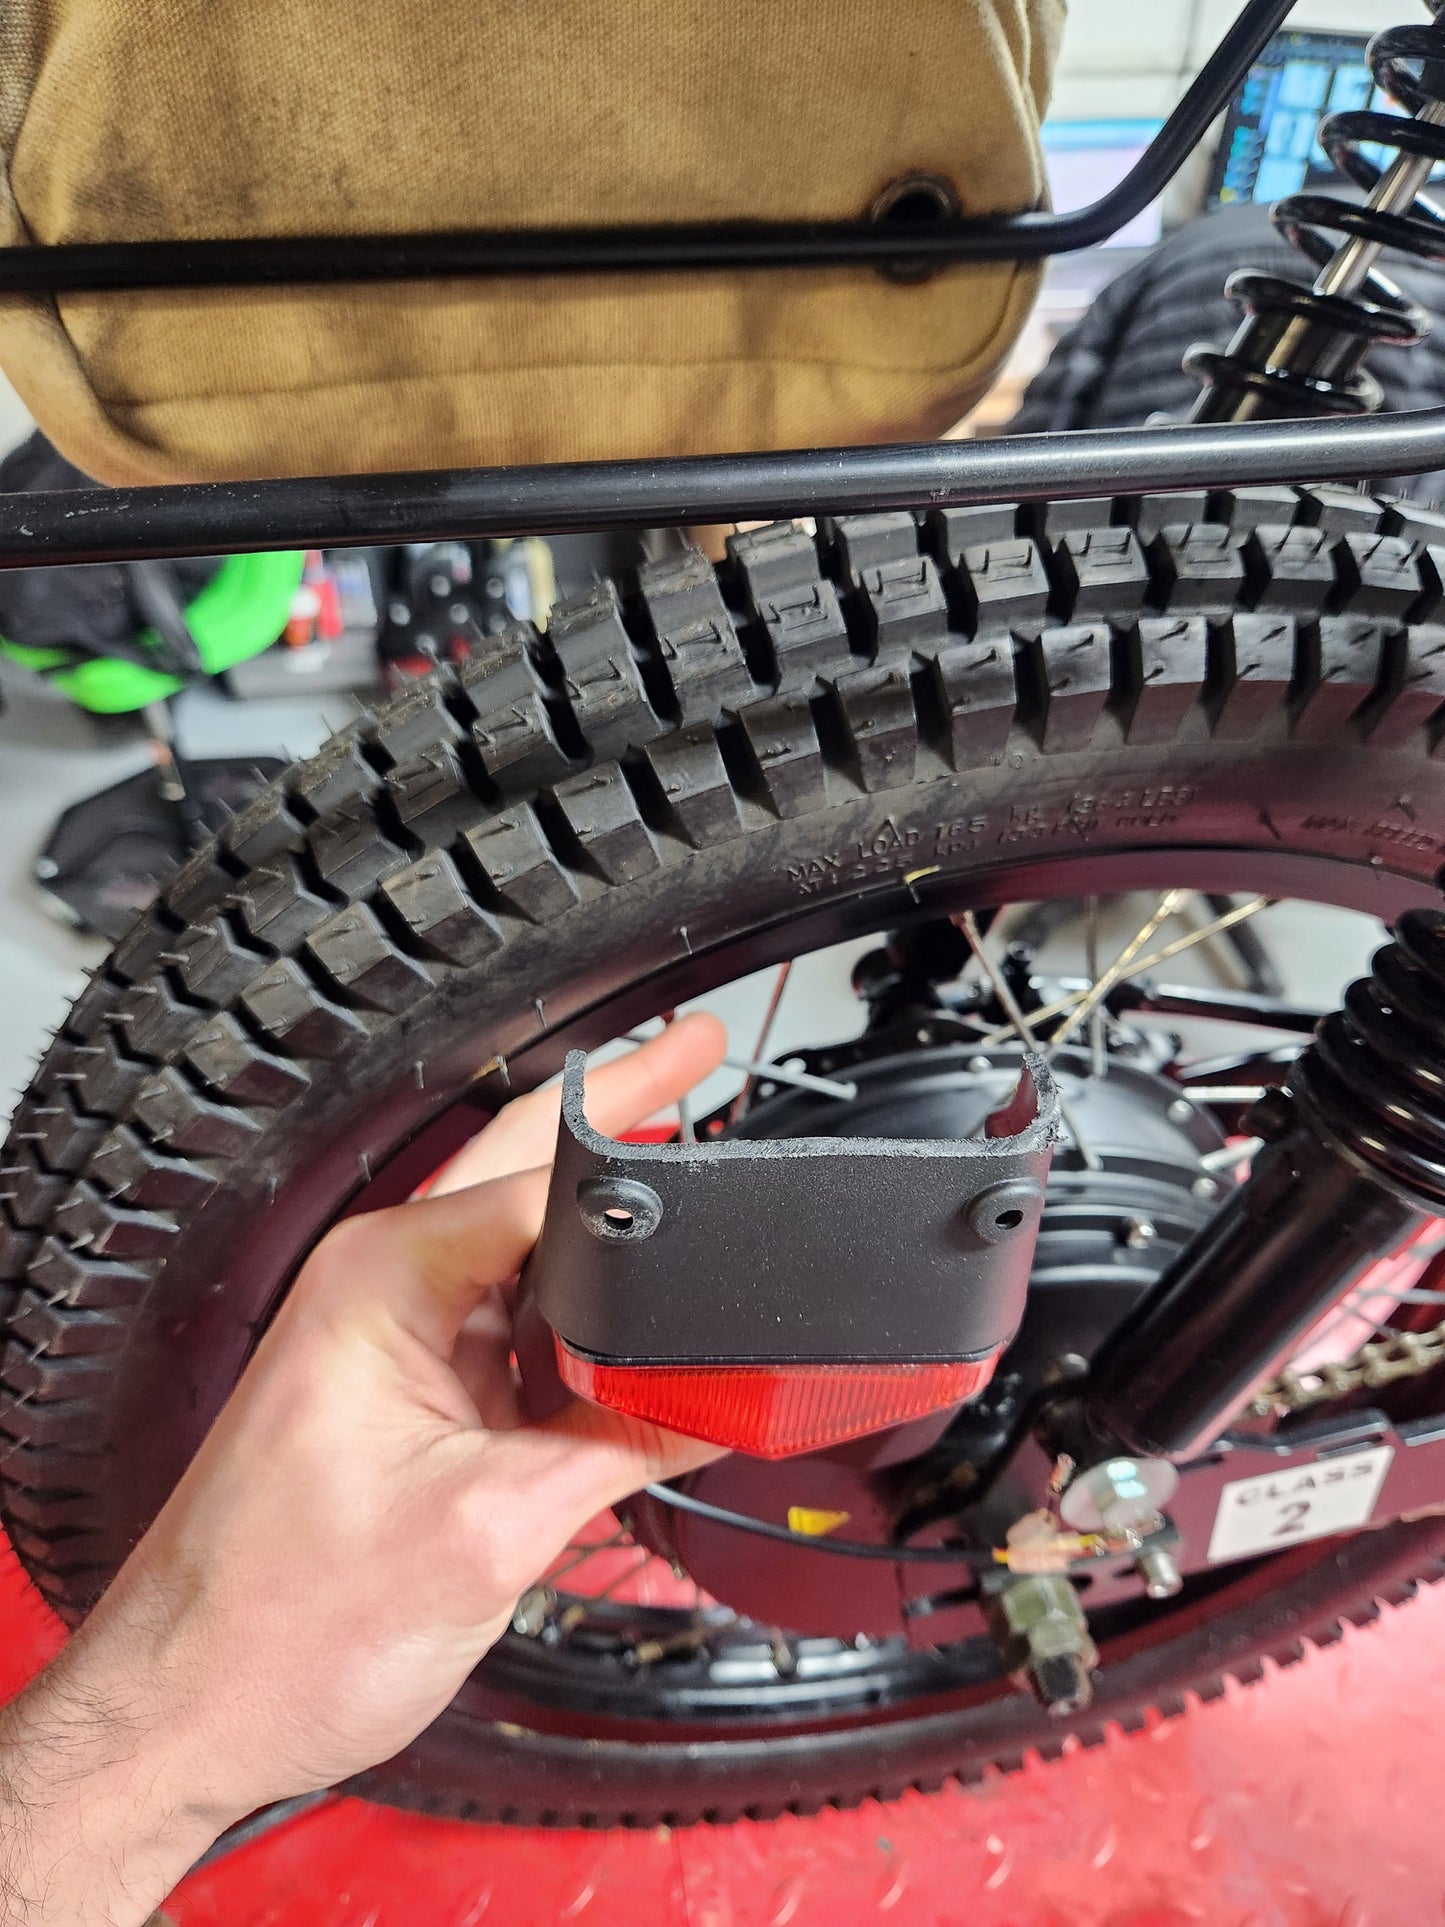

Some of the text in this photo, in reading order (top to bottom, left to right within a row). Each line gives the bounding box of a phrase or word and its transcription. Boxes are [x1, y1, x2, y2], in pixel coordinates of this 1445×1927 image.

[787, 851, 841, 882] MAX
[858, 828, 919, 859] LOAD
[1235, 1459, 1375, 1506] CLASS
[1271, 1500, 1312, 1536] 2
